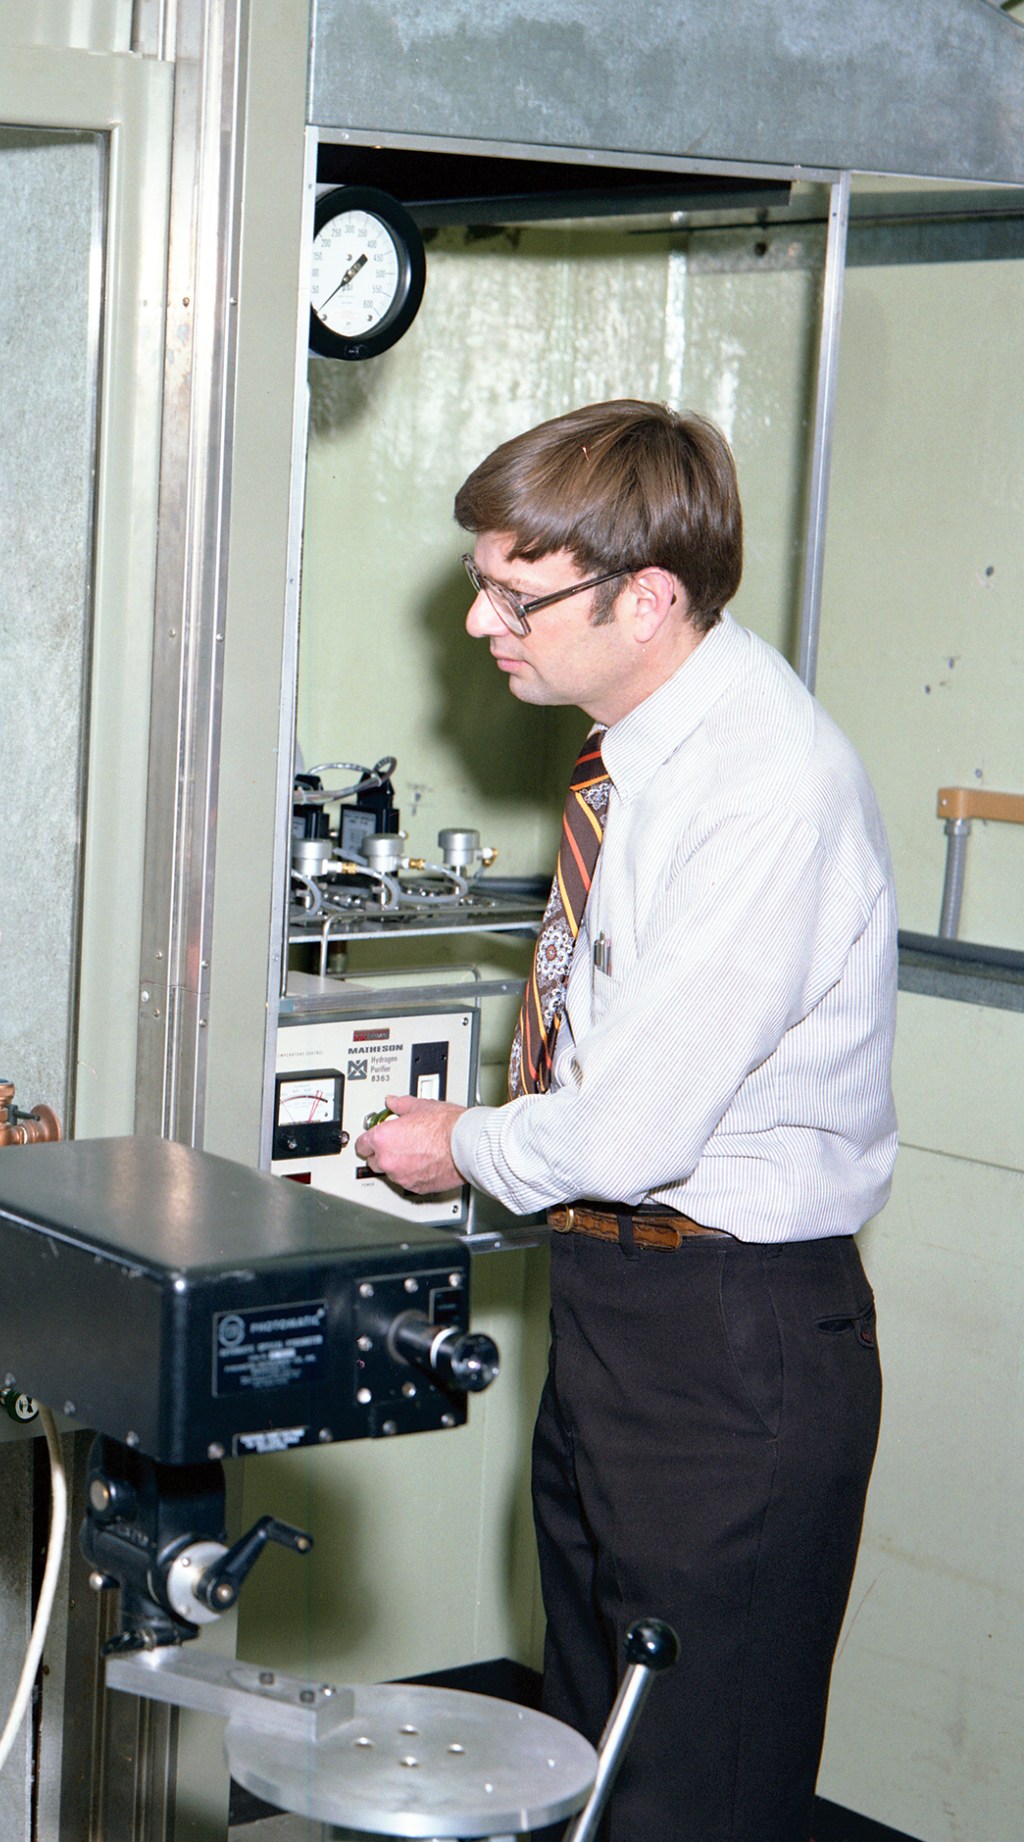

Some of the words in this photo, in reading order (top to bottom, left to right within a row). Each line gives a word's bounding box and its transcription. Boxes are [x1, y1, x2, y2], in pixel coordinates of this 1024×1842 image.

[348, 1044, 403, 1055] MATHESON
[371, 1056, 398, 1065] Hydrogen
[371, 1065, 391, 1073] Purifier
